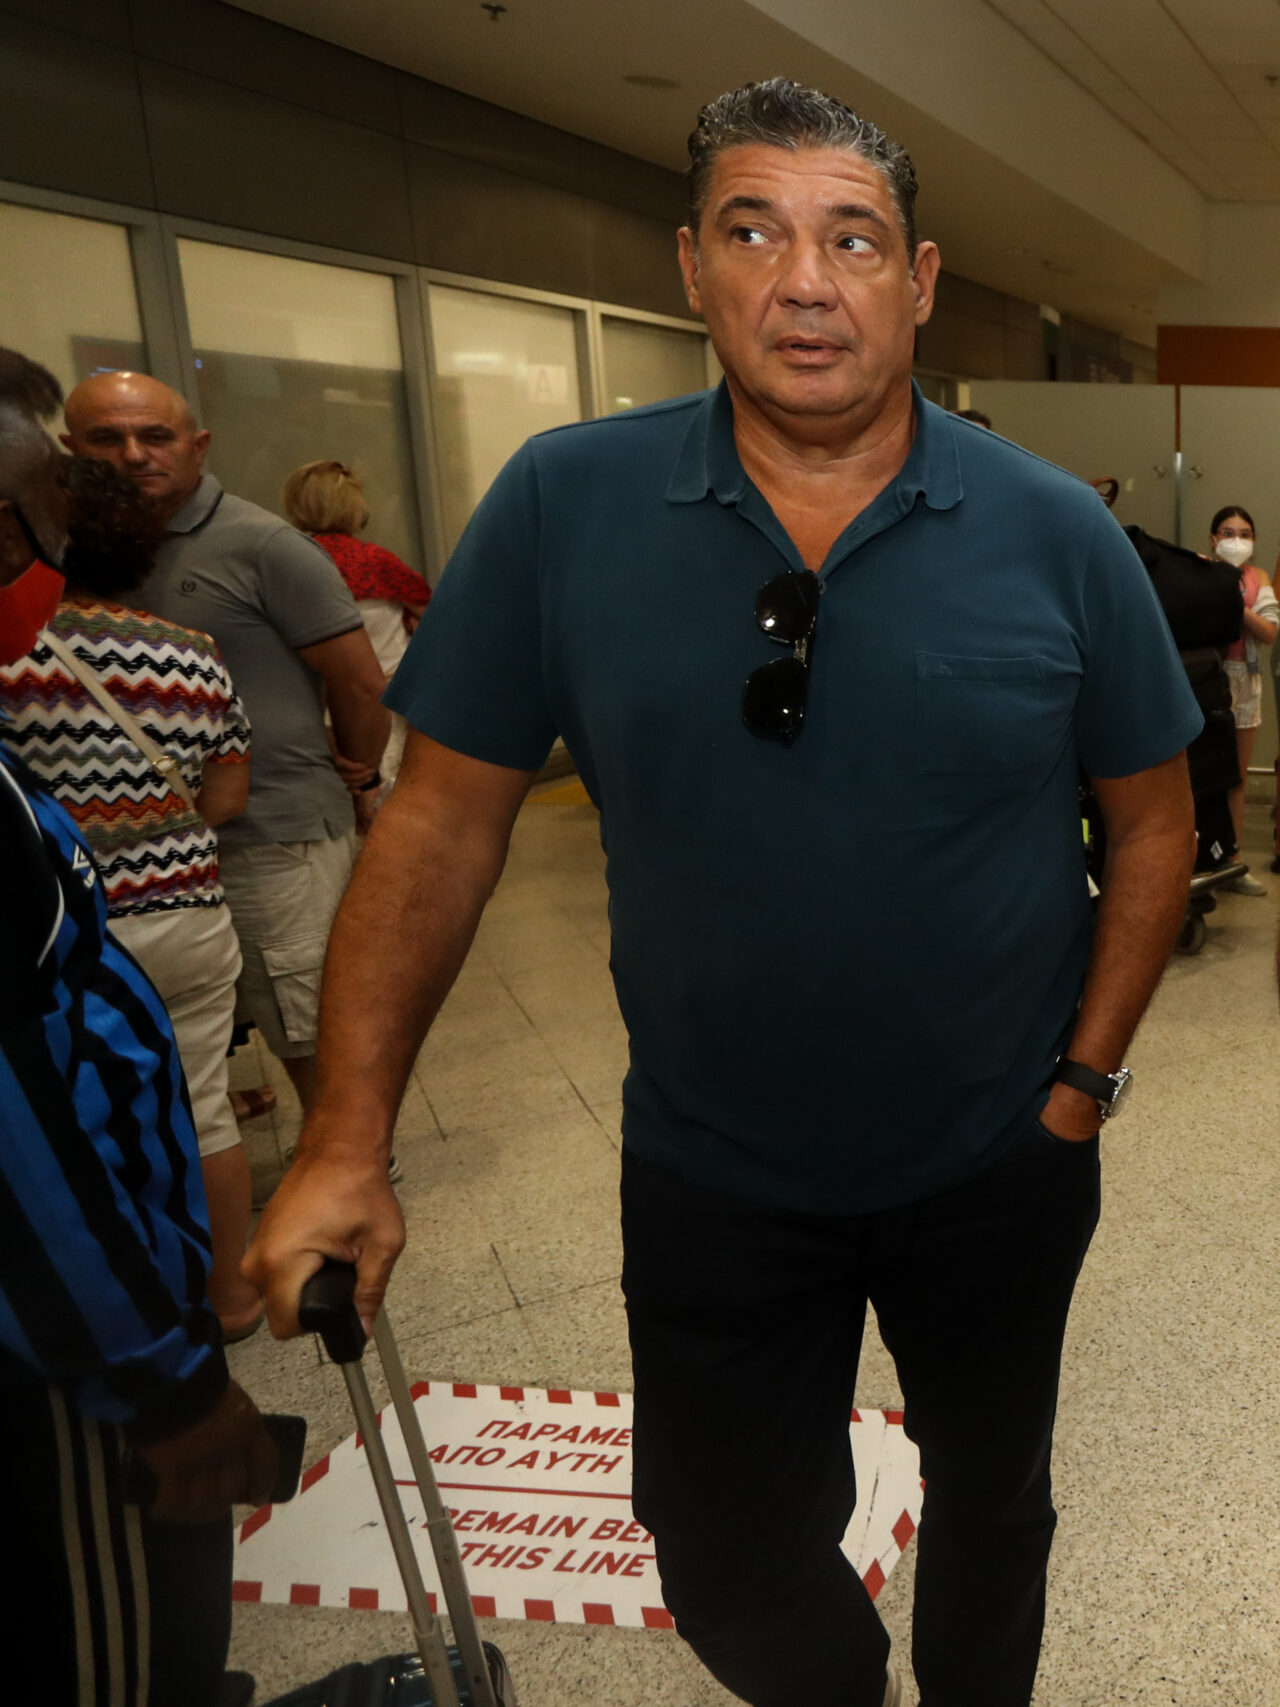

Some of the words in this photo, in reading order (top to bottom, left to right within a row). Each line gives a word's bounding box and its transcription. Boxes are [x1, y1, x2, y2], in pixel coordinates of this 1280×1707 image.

[428, 1444, 506, 1466] ΑΠΟ
[506, 1450, 624, 1474] ΑΥΤΗ
[460, 1542, 552, 1570] THIS
[553, 1549, 656, 1577] LINE
